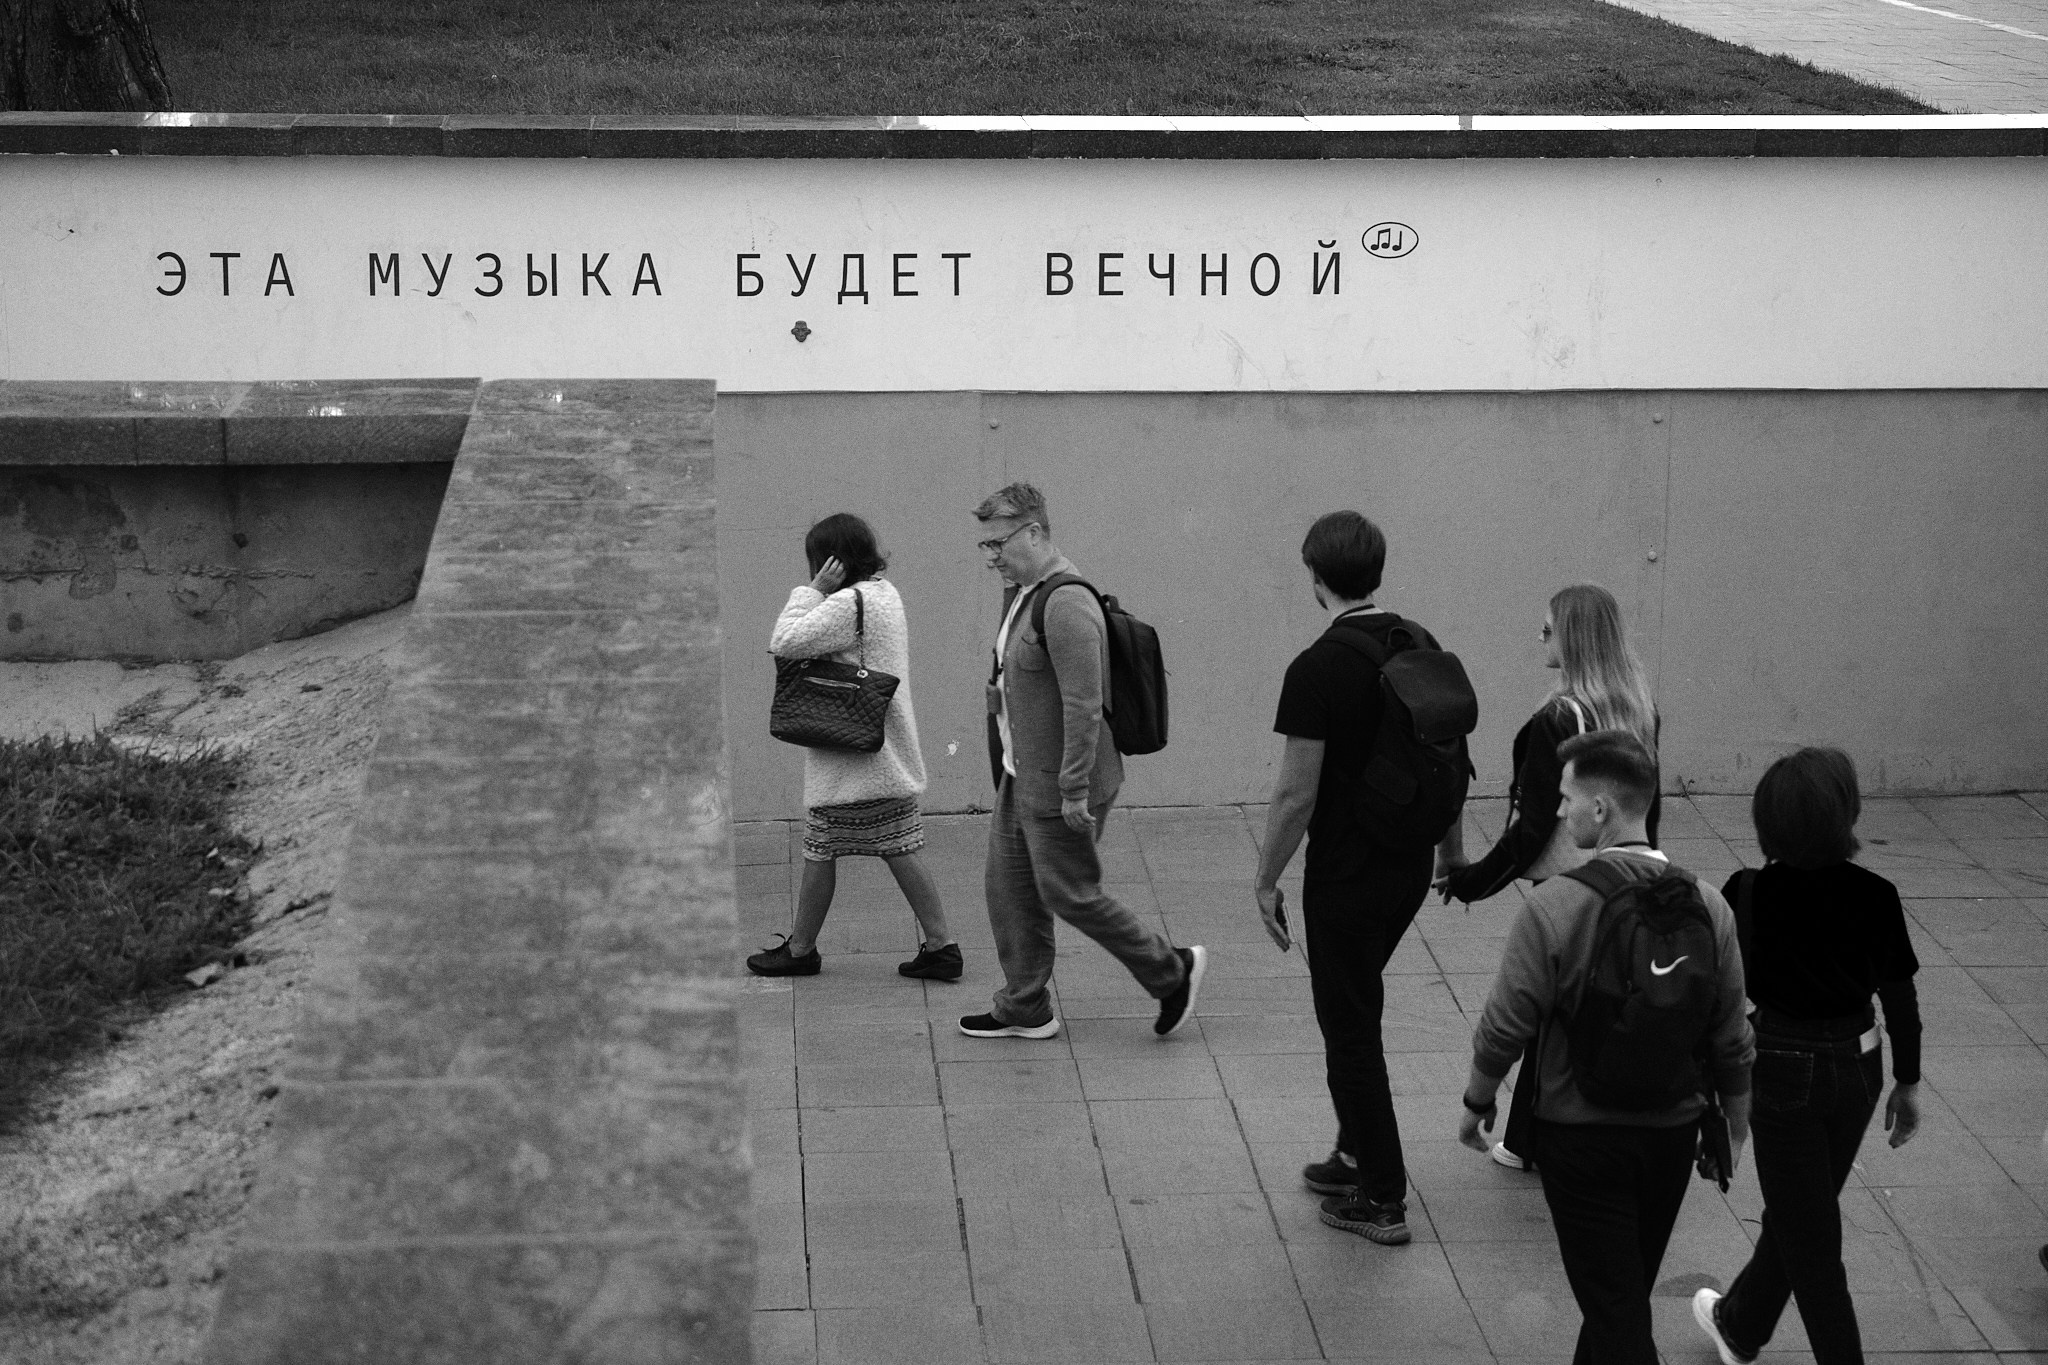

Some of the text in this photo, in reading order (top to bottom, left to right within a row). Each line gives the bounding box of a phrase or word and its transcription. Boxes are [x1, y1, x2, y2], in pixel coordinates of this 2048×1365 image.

[156, 239, 1341, 304] ЭТА МУЗЫКА БУДЕТ ВЕЧНОЙ
